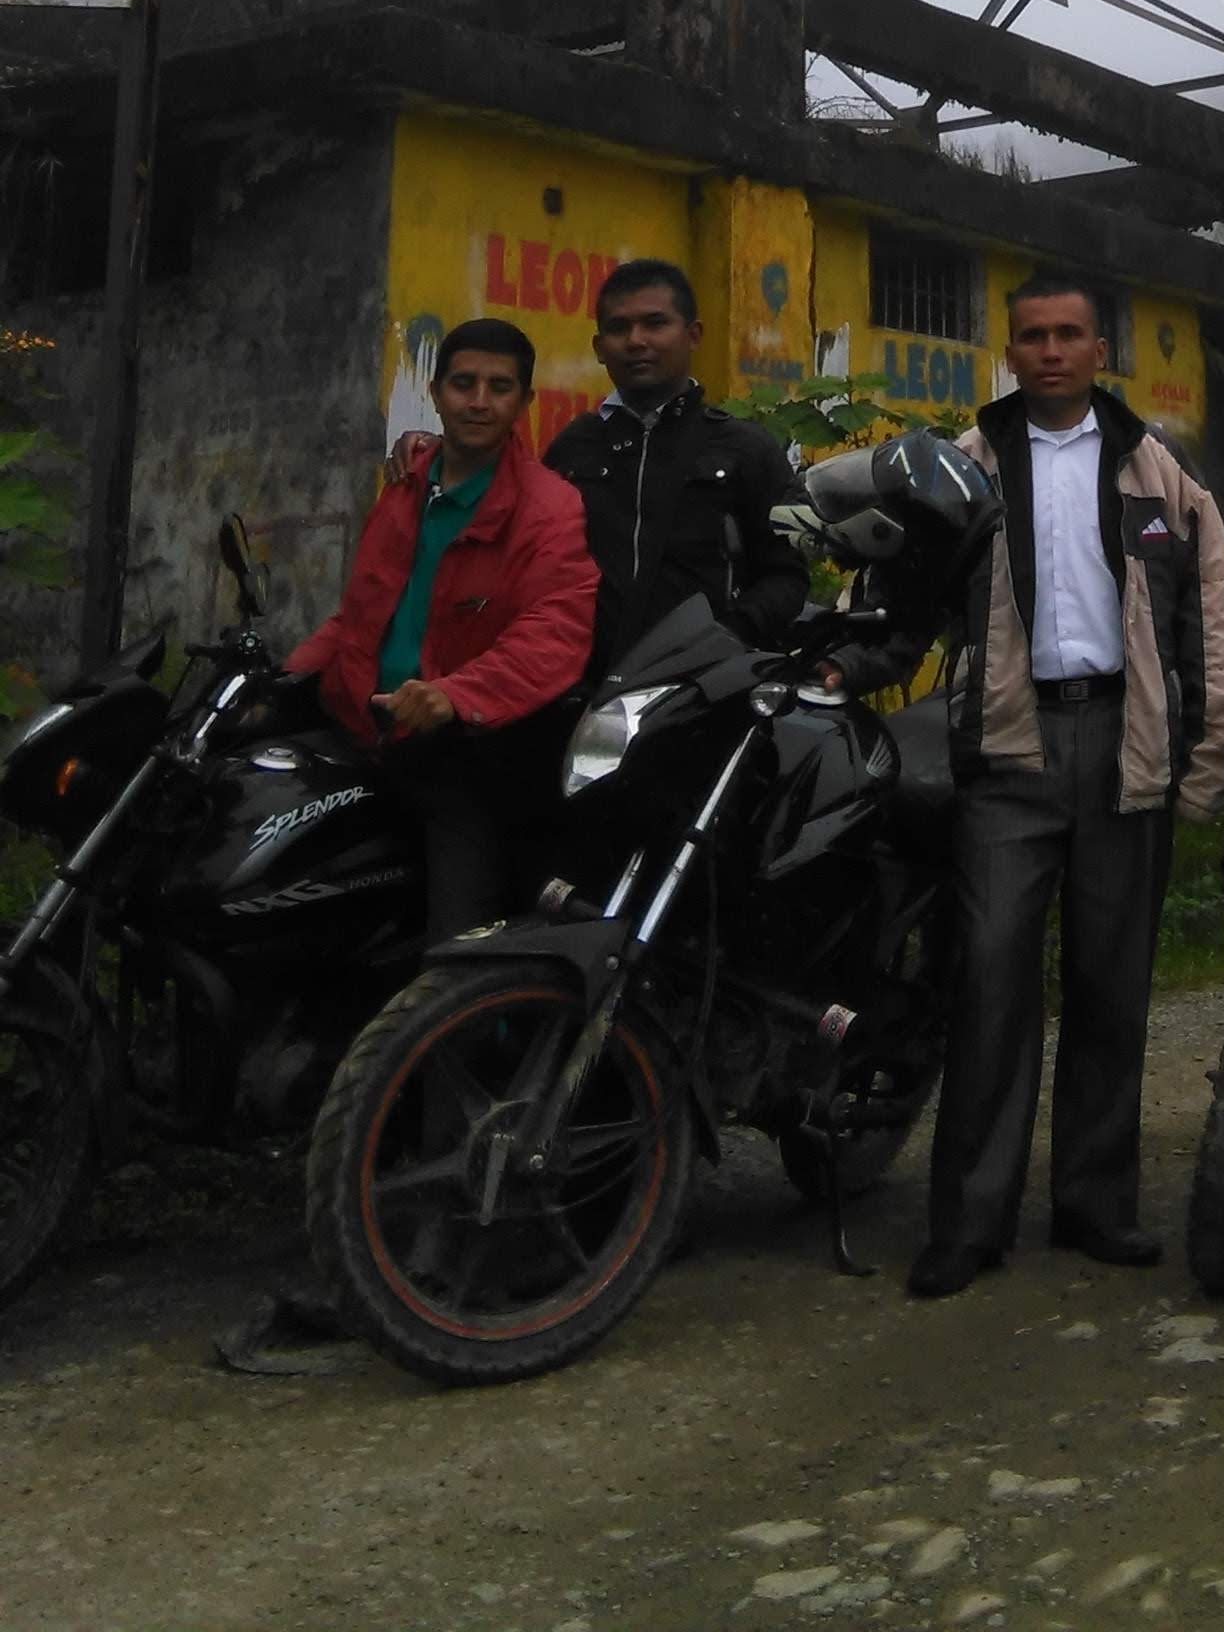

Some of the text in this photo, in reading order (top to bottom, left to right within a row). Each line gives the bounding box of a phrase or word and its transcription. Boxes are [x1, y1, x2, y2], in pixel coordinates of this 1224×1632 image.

[884, 340, 975, 406] LEON
[249, 786, 375, 850] SPLENDOR
[220, 868, 407, 916] NXG HONDA
